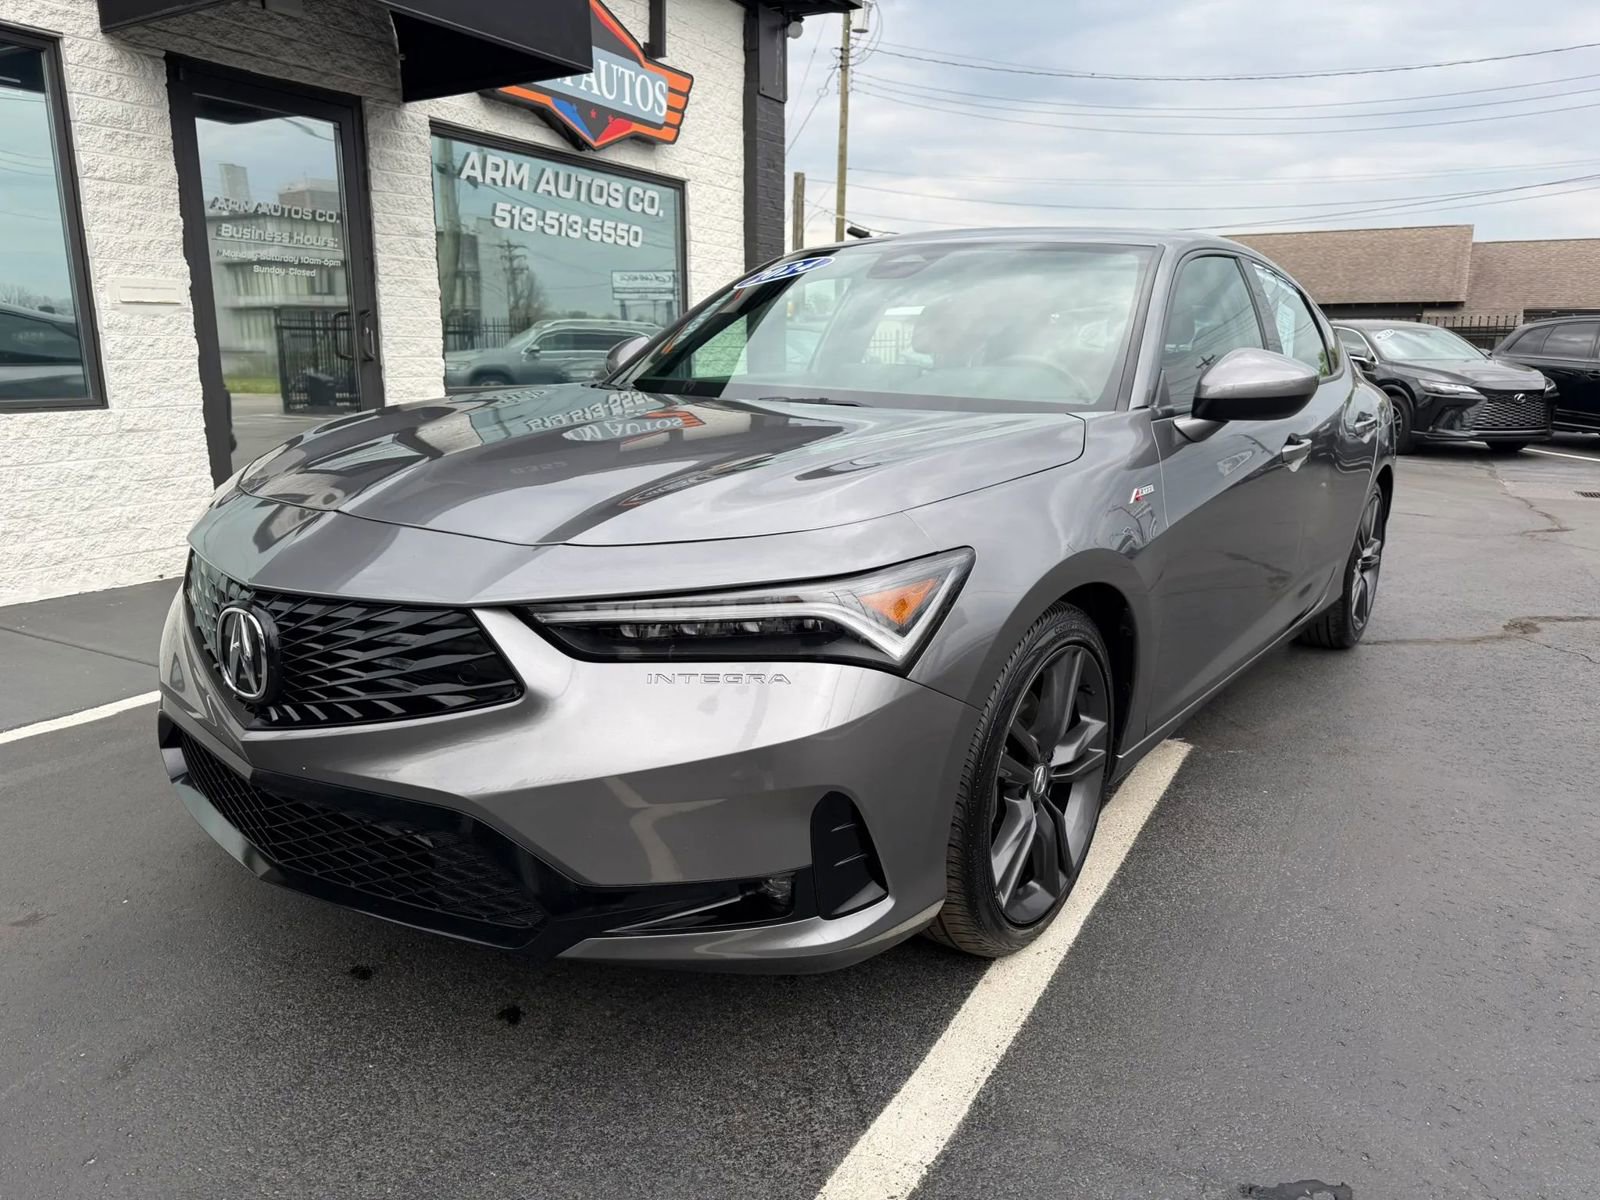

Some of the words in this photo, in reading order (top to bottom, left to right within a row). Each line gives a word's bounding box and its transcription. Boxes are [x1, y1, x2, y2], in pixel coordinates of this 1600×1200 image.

[579, 59, 667, 117] AUTOS
[460, 151, 530, 190] ARM
[537, 167, 623, 208] AUTOS
[628, 186, 664, 217] CO.
[255, 202, 312, 221] AUTOS
[315, 208, 340, 224] CO.
[493, 202, 643, 248] 513-513-5550
[221, 223, 290, 243] Business
[293, 231, 339, 248] Hours:
[253, 264, 286, 276] Sunday
[288, 267, 317, 277] Closed
[647, 673, 791, 685] INTEGRA
